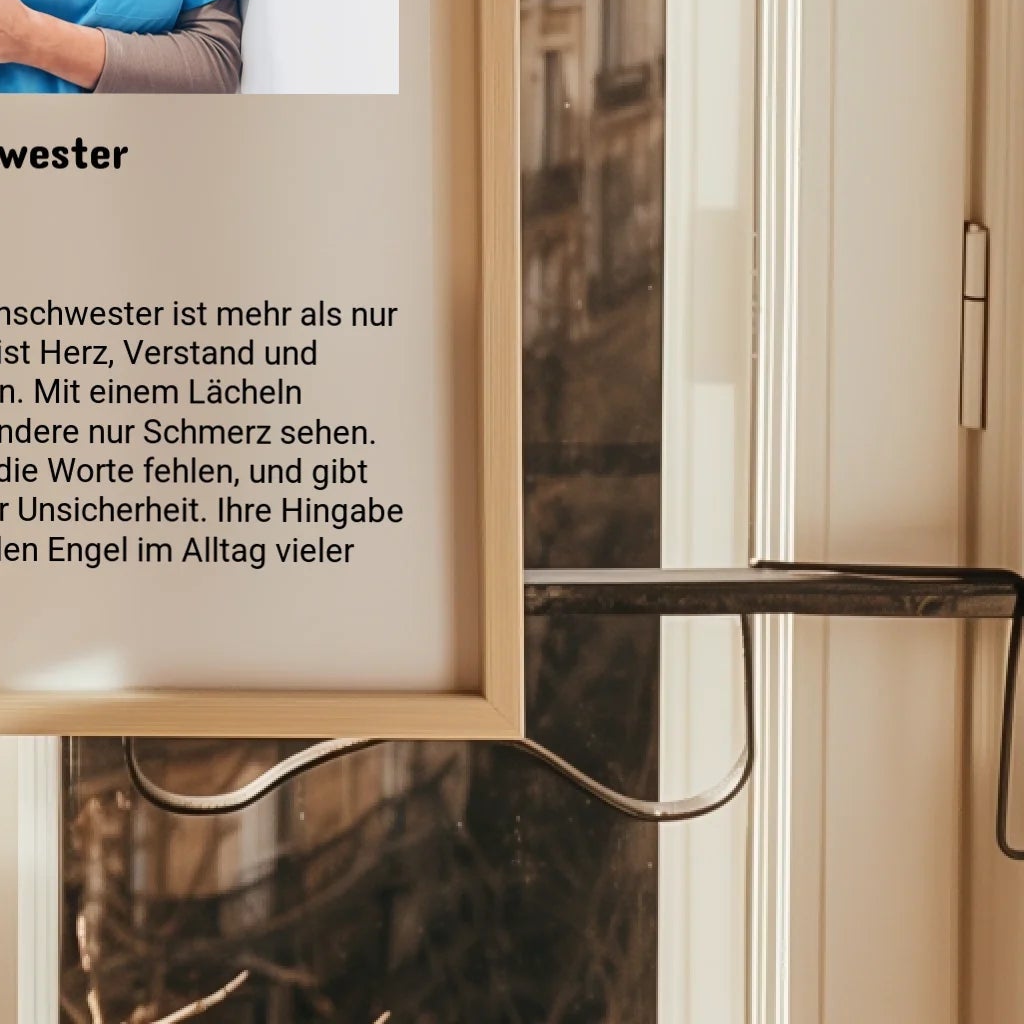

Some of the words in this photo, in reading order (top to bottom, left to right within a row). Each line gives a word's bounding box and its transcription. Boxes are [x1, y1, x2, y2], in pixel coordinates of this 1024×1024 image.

[173, 300, 208, 326] ist
[217, 299, 293, 327] mehr
[300, 300, 342, 327] als
[352, 307, 399, 327] nur
[41, 339, 114, 369] Herz,
[122, 338, 254, 366] Verstand
[265, 339, 317, 366] und
[35, 378, 81, 404] Mit
[89, 378, 179, 404] einem
[189, 377, 302, 405] Lächeln
[89, 424, 136, 444] nur
[143, 417, 272, 445] Schmerz
[280, 418, 376, 445] sehen.
[47, 457, 134, 483] Worte
[143, 456, 240, 488] fehlen,
[249, 457, 302, 484] und
[312, 457, 368, 491] gibt
[18, 495, 207, 523] Unsicherheit.
[218, 496, 272, 523] Ihre
[282, 496, 404, 530] Hingabe
[48, 535, 127, 569] Engel
[138, 536, 173, 563] im
[181, 536, 266, 570] Alltag
[275, 536, 355, 563] vieler
